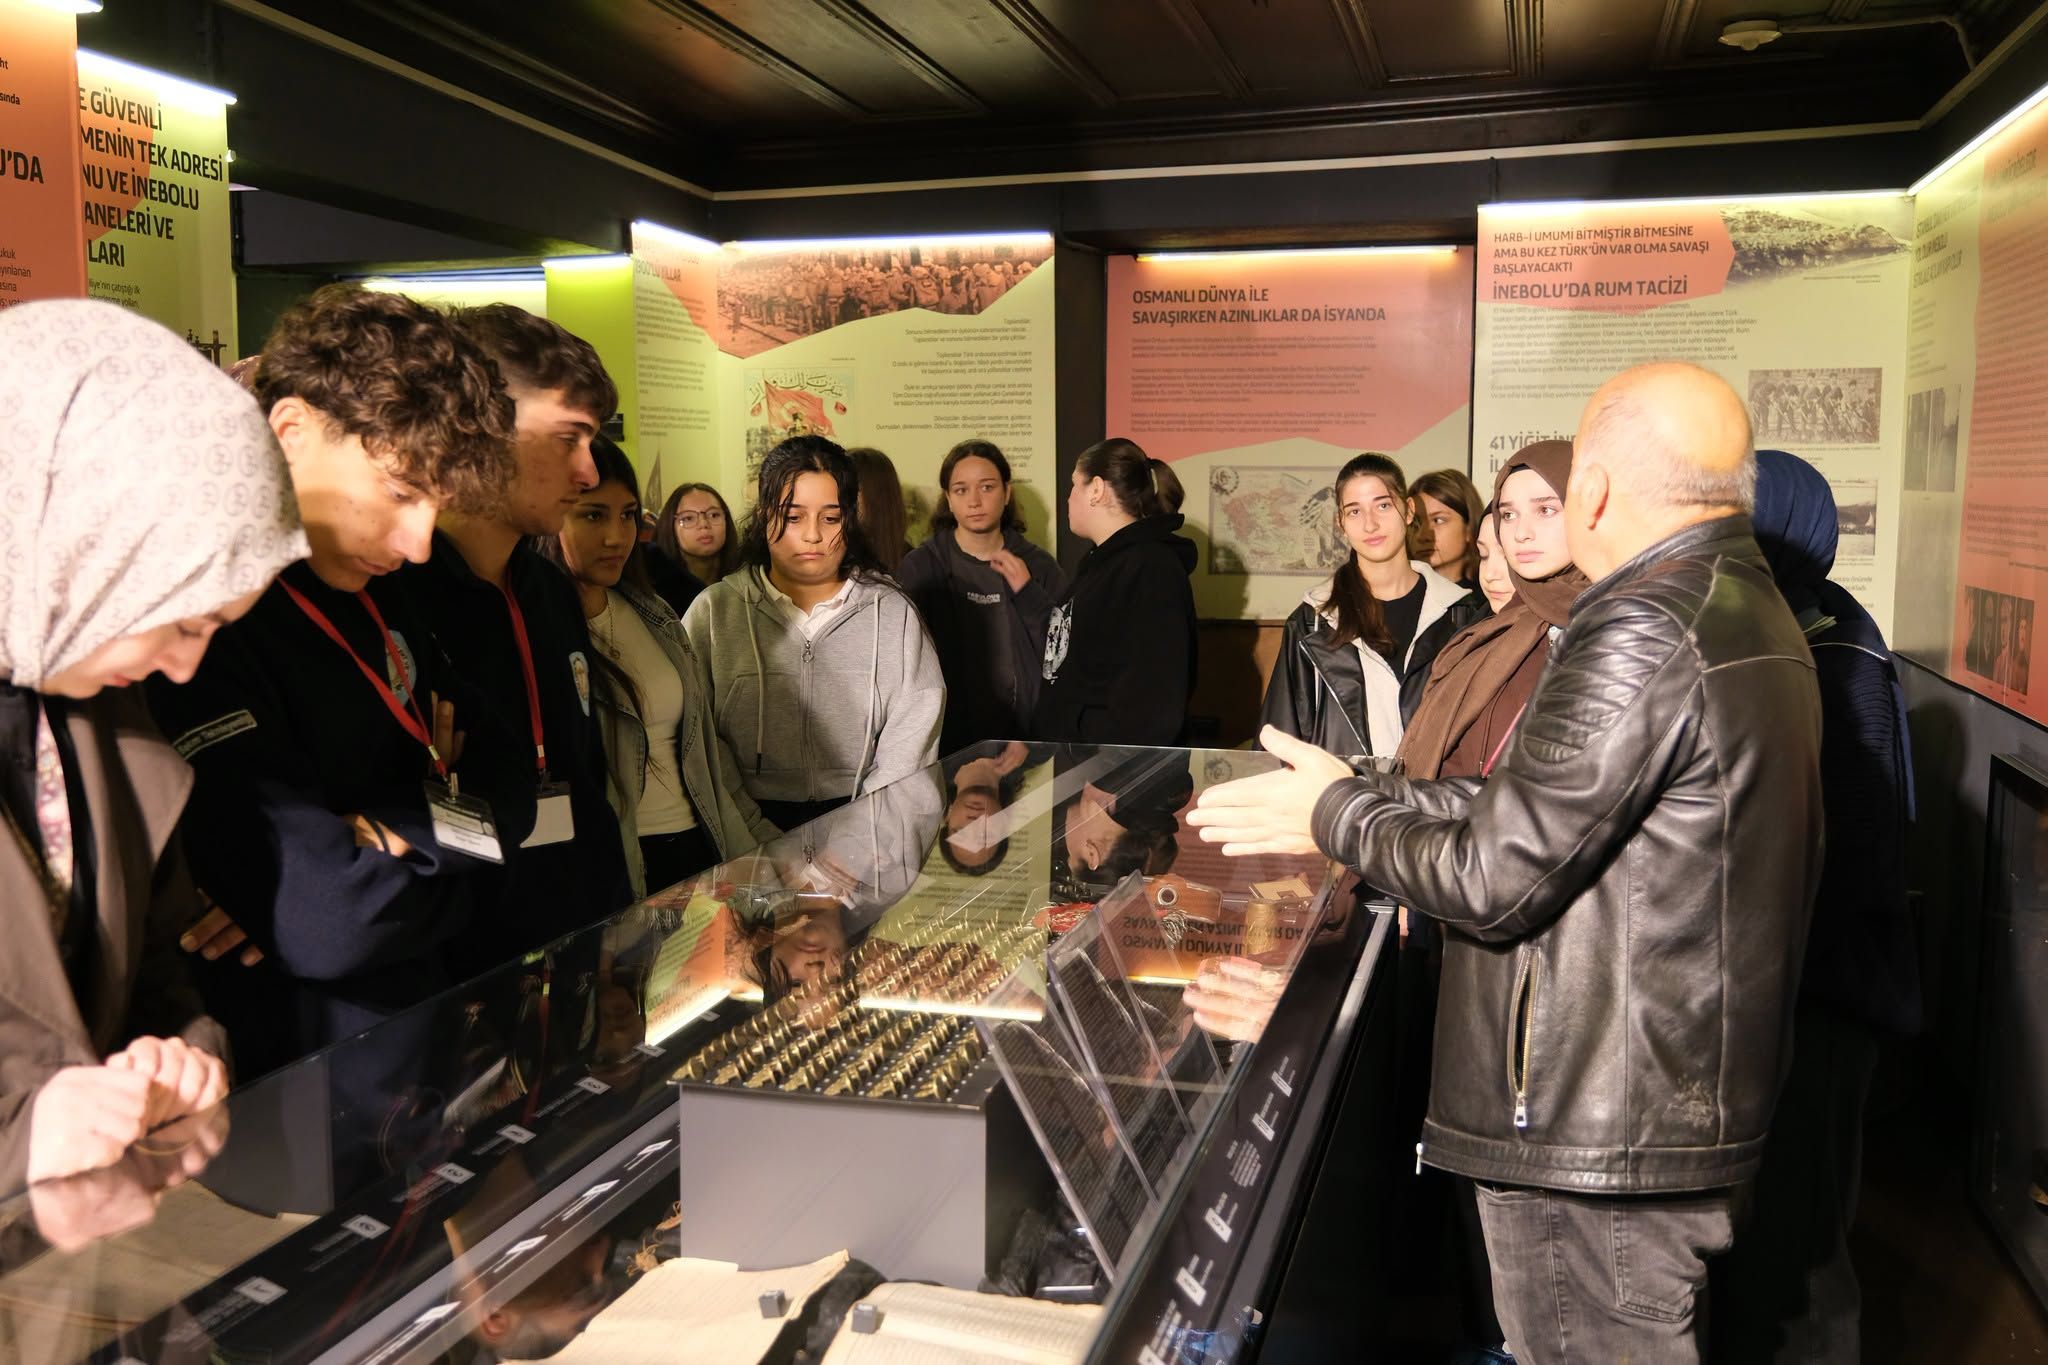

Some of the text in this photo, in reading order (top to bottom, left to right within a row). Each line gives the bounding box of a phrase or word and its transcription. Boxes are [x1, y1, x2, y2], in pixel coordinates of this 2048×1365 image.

[91, 86, 163, 131] GÜVENLİ
[137, 139, 169, 169] TEK
[170, 148, 223, 182] ADRESİ
[106, 167, 129, 196] VE
[131, 166, 199, 211] İNEBOLU
[84, 200, 175, 240] ANELERİ VE
[1576, 225, 1631, 242] BİTMİŞTİR
[1633, 223, 1694, 238] BİTMESİNE
[87, 238, 125, 267] LARI
[1494, 247, 1518, 258] AMA
[1520, 247, 1535, 258] BU
[1537, 246, 1557, 257] KEZ
[1610, 244, 1632, 254] VAR
[1634, 242, 1667, 254] OLMA
[1669, 240, 1709, 255] SAVAŞI
[1493, 261, 1573, 277] BAŞLAYACAKTI
[1132, 284, 1269, 304] OSMANLI DÜNYA İLE
[1493, 274, 1688, 300] İNEBOLU'DA RUM TACİZİ
[1132, 304, 1386, 328] SAVAŞIRKEN AZINLIKLAR DA İSYANDA
[1489, 434, 1505, 450] 41
[1508, 430, 1551, 450] YİĞİ
